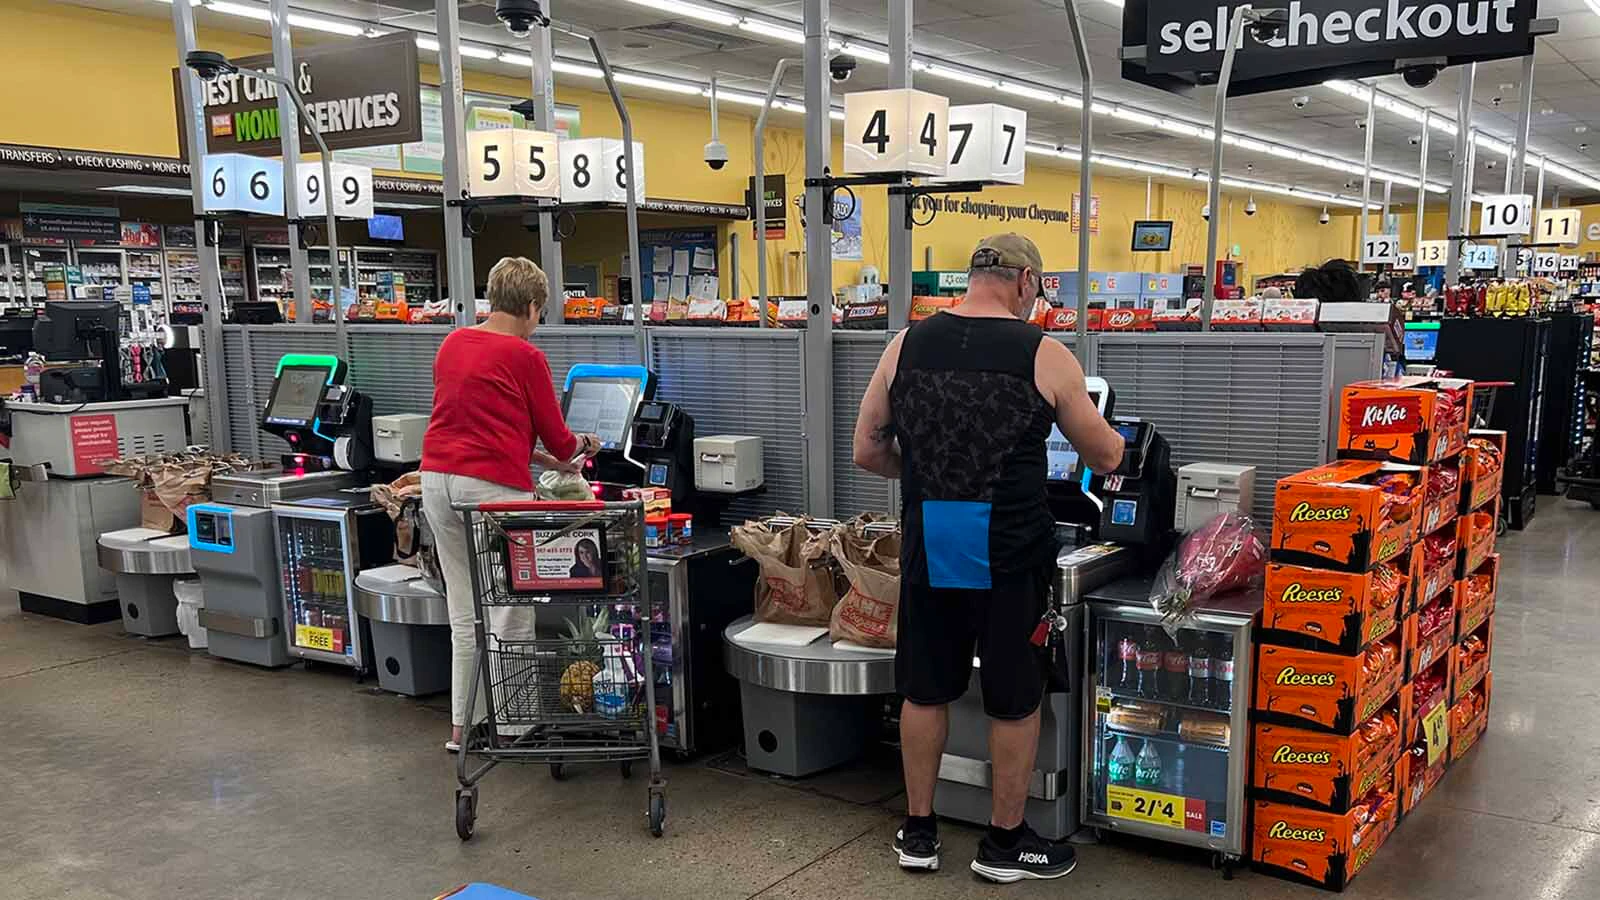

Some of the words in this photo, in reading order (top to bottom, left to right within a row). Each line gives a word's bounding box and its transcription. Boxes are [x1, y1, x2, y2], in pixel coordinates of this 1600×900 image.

[299, 62, 313, 94] &
[862, 109, 890, 154] 4
[919, 112, 937, 156] 4
[949, 123, 973, 165] 7
[1002, 125, 1016, 165] 7
[0, 149, 55, 164] TRANSFERS
[75, 155, 104, 168] CHECK
[106, 157, 143, 171] CASHING
[152, 161, 182, 174] MONEY
[483, 145, 501, 181] 5
[529, 146, 546, 181] 5
[572, 153, 591, 188] 8
[212, 167, 226, 197] 6
[250, 170, 270, 201] 6
[307, 175, 320, 204] 9
[342, 176, 360, 205] 9
[944, 194, 960, 213] for
[960, 196, 1006, 222] shopping
[1006, 205, 1028, 222] your
[1028, 202, 1070, 225] Cheyenne
[1486, 203, 1519, 226] 10
[1544, 217, 1569, 235] 11
[1366, 240, 1390, 258] 12
[1420, 246, 1440, 261] 13
[1468, 250, 1486, 263] 14
[1396, 256, 1409, 266] 19
[1539, 256, 1554, 267] 16
[1562, 258, 1575, 267] 21
[1361, 404, 1407, 427] KitKat
[1289, 502, 1351, 523] Reese's
[1281, 583, 1343, 603] Reese's
[309, 634, 329, 647] FREE
[1275, 667, 1336, 687] Reese's
[1272, 745, 1331, 764] Reese's
[1185, 811, 1202, 820] SALE
[1269, 820, 1326, 842] Reese's
[1017, 851, 1049, 865] HOKA
